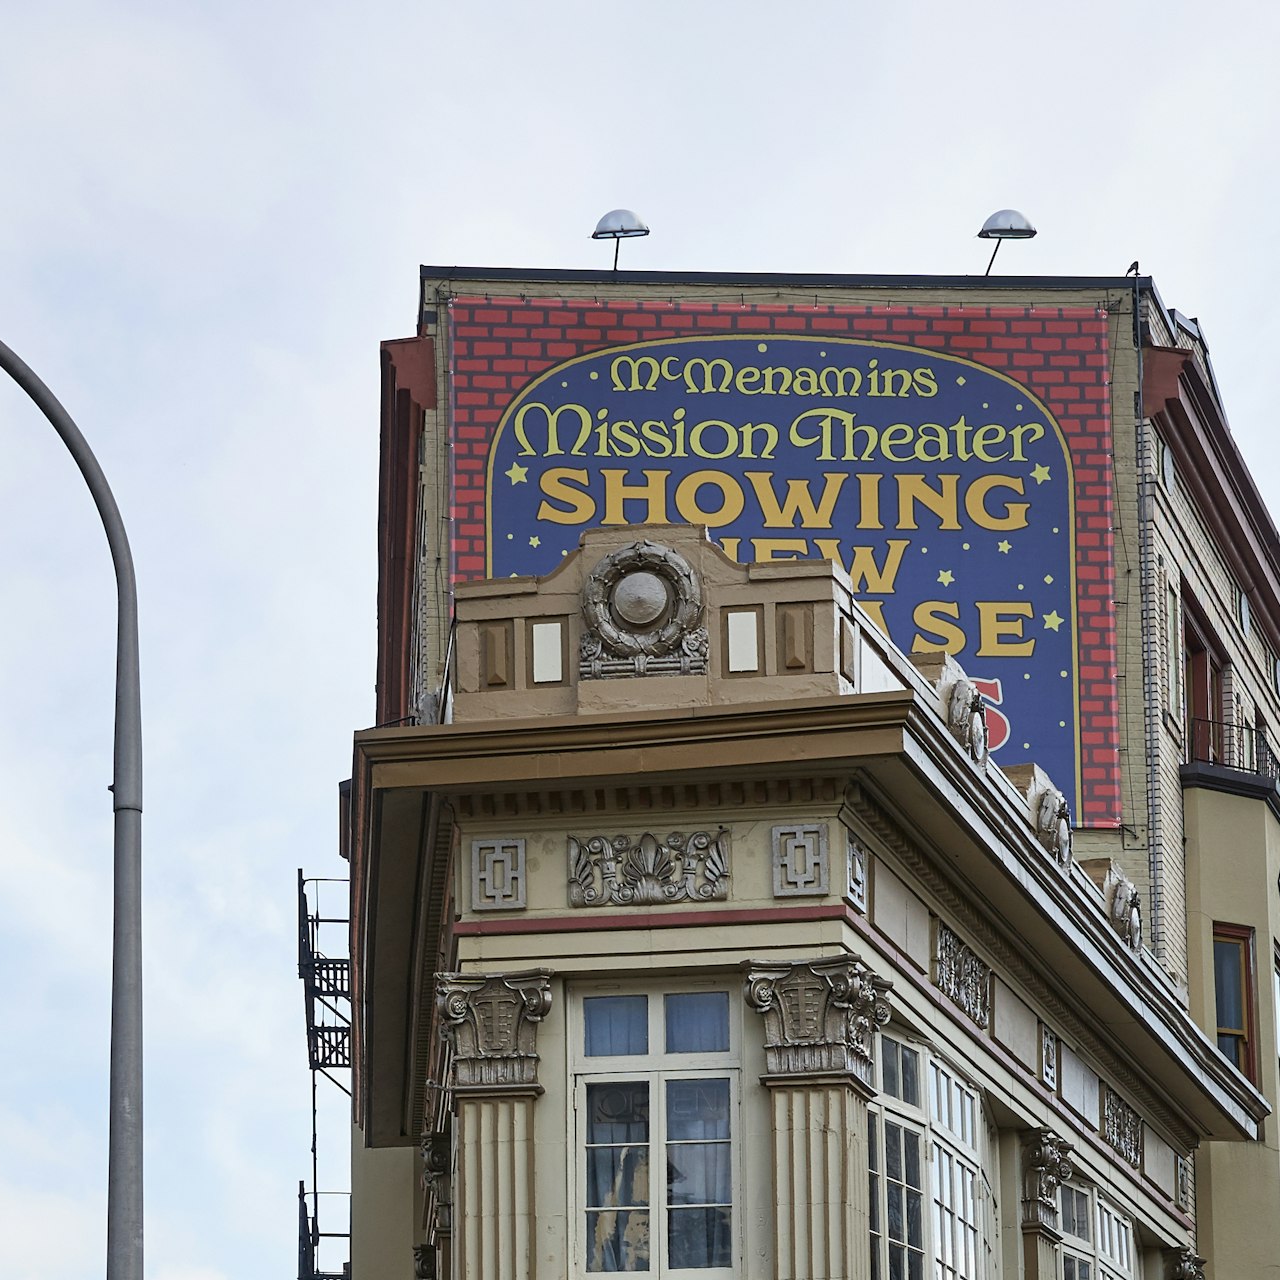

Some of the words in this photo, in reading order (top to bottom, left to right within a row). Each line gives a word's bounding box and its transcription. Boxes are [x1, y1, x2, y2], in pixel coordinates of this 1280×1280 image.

[610, 354, 938, 398] McMenamins
[514, 402, 779, 460] Mission
[789, 405, 1045, 464] Theater
[535, 467, 1032, 533] SHOWING
